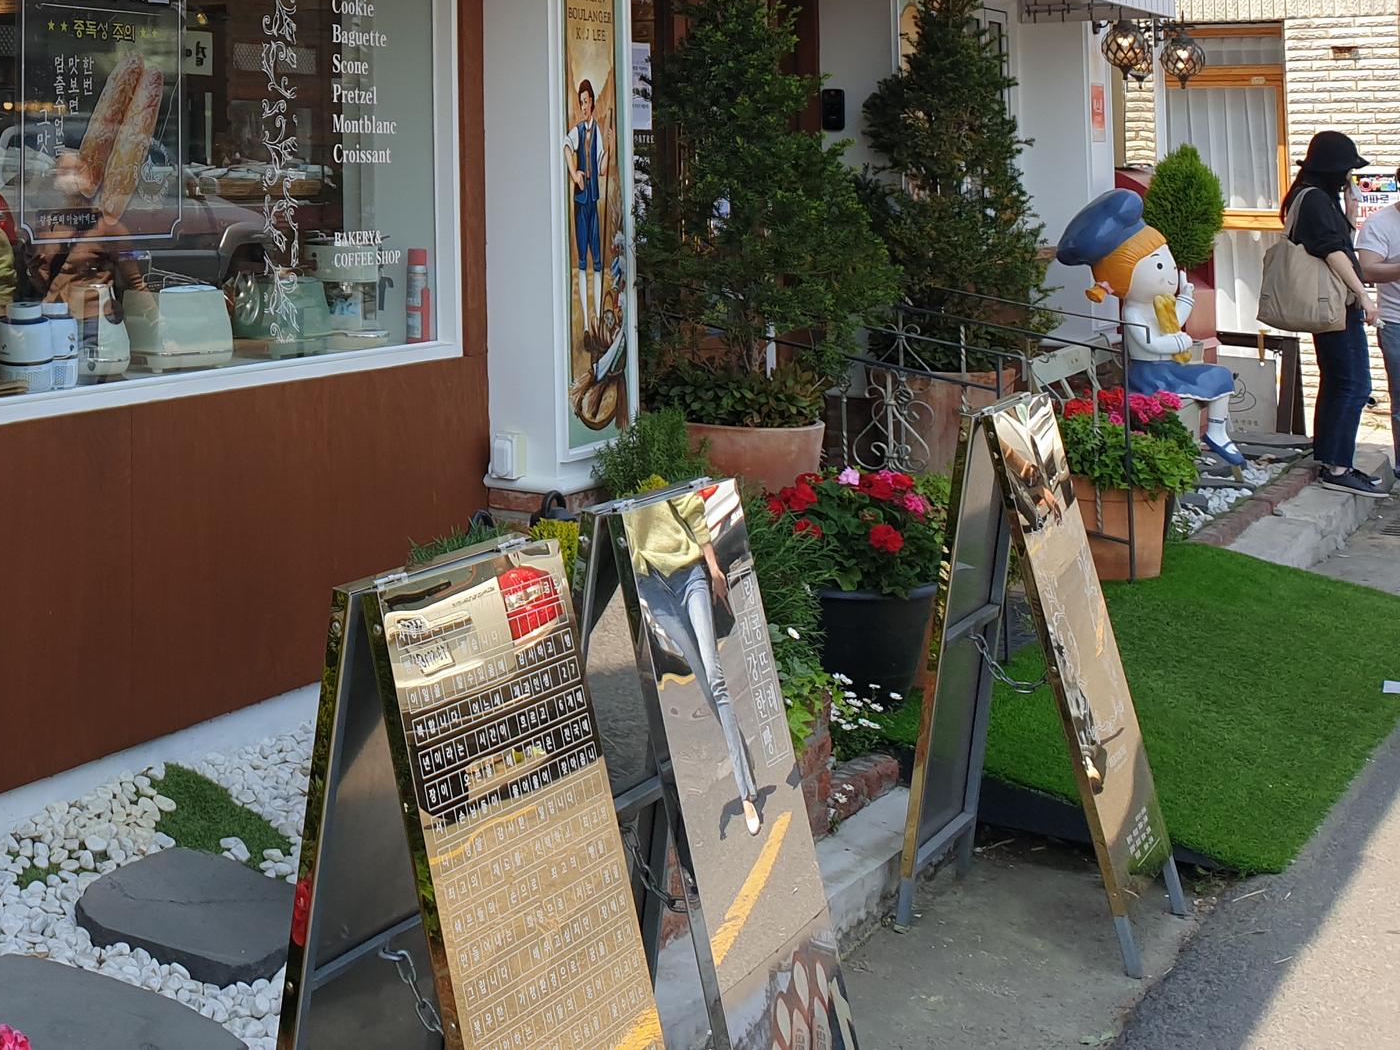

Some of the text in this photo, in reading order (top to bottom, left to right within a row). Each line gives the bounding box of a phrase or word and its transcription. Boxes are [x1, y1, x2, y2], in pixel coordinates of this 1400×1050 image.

[73, 20, 136, 42] 중독성 주의
[331, 23, 387, 50] Baguette
[593, 29, 607, 41] LEE
[332, 54, 369, 76] Scone
[332, 84, 378, 106] Pretzel
[332, 114, 397, 136] Montblanc
[332, 144, 392, 165] Croissant
[334, 230, 382, 247] BAKERY&
[334, 249, 401, 268] COFFEE SHOP
[470, 693, 500, 717] 어느새
[560, 662, 577, 680] 27
[421, 741, 464, 771] 년이라는
[476, 723, 506, 748] 시간이
[518, 706, 545, 730] 흐르고
[428, 782, 448, 804] 장이
[434, 819, 443, 837] 서
[456, 794, 497, 826] 손님들이
[510, 770, 548, 800] 물어물어
